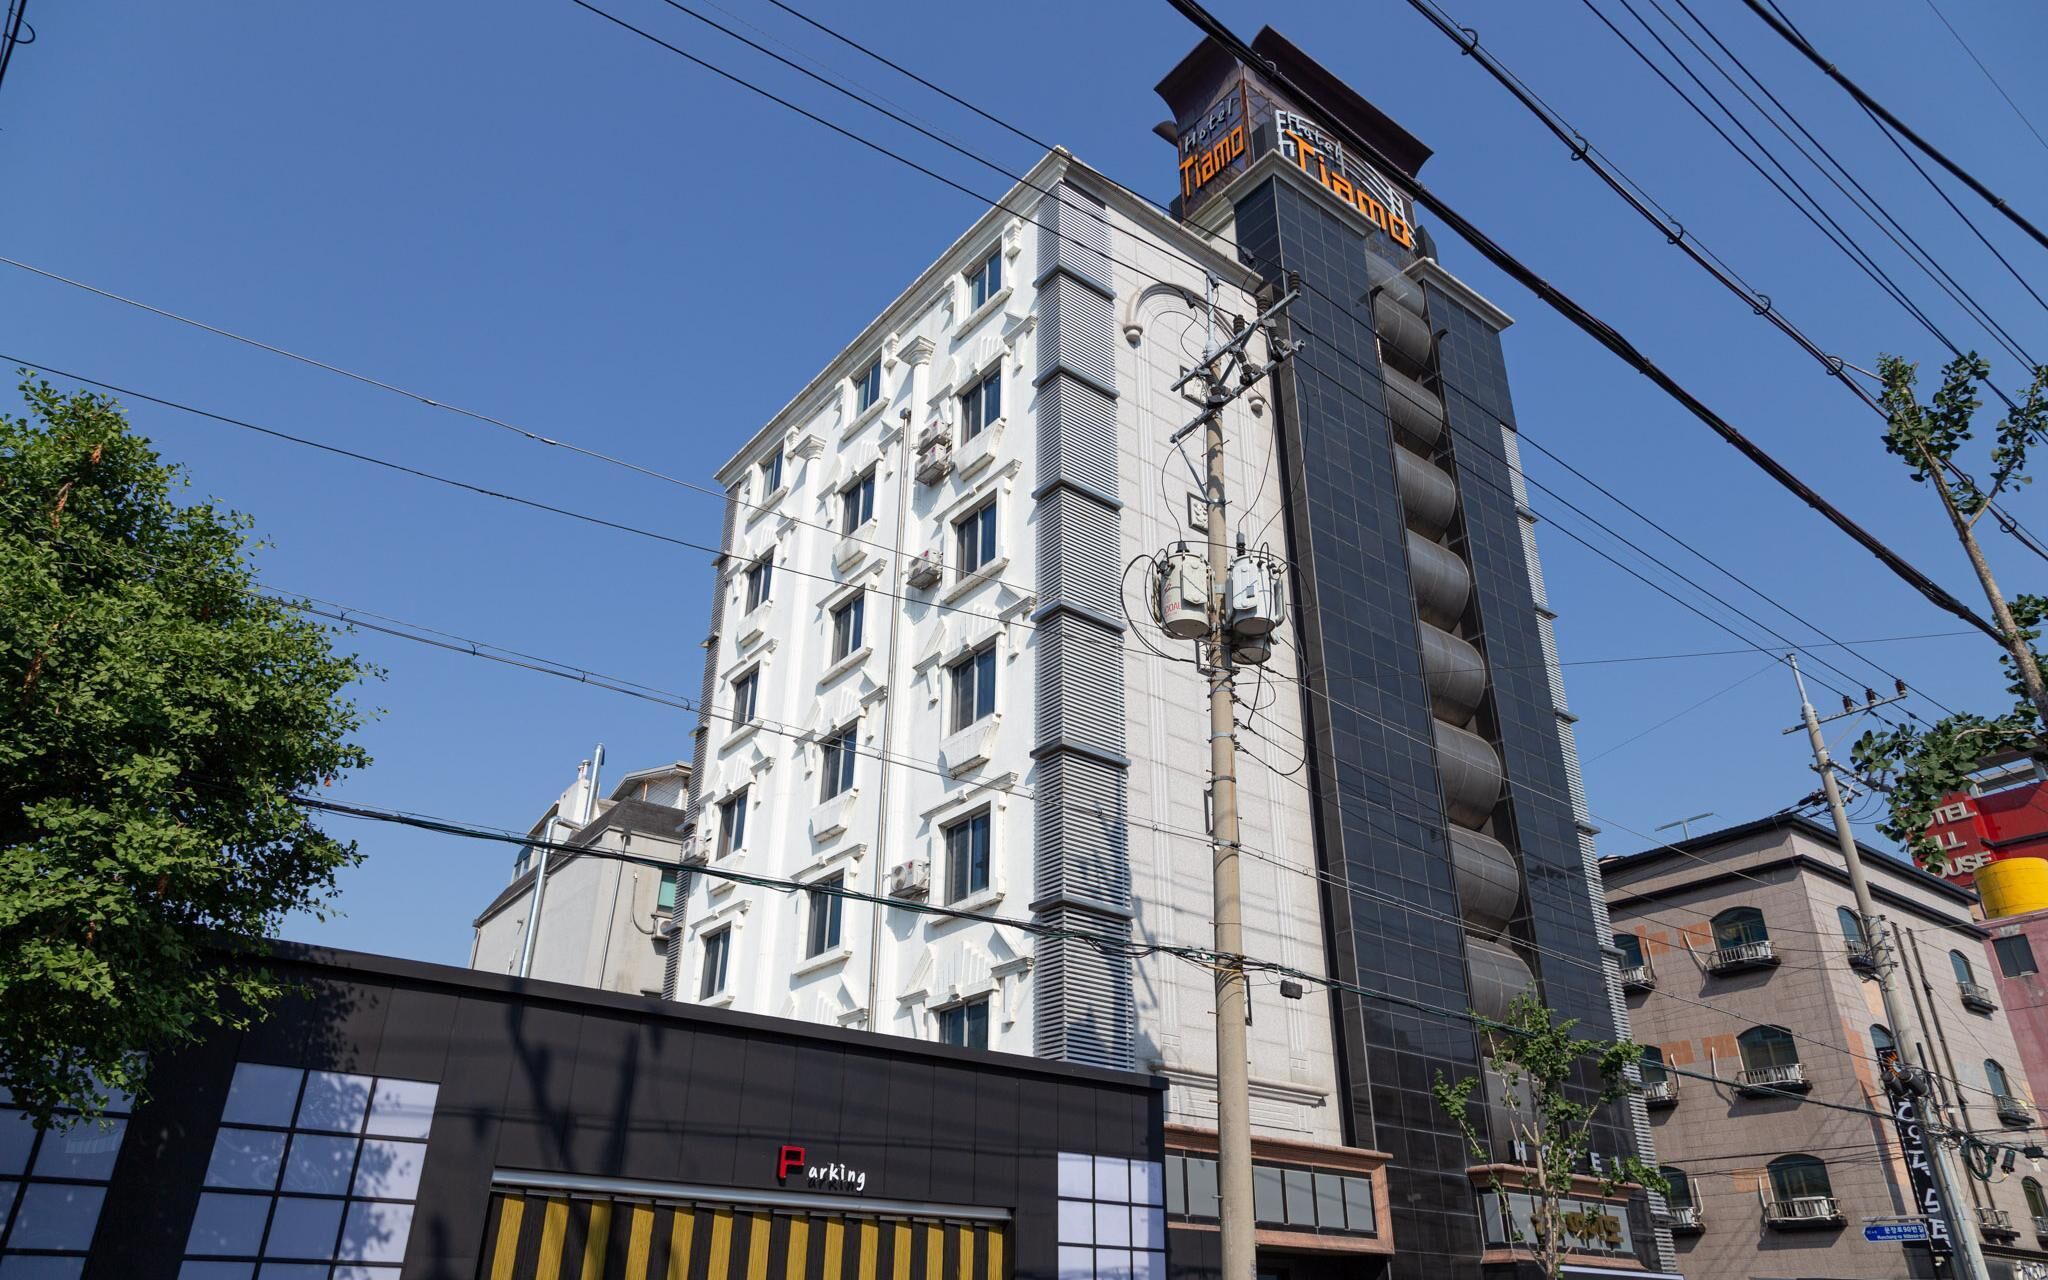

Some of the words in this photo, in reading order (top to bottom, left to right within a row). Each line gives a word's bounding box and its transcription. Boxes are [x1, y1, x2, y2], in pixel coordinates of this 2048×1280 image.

[1184, 97, 1233, 153] Hotel
[1179, 125, 1245, 197] Tiamo
[1284, 129, 1411, 248] Tiamo
[1922, 801, 1977, 830] TEL
[1923, 850, 1992, 880] OUSE
[780, 1145, 866, 1191] Parking
